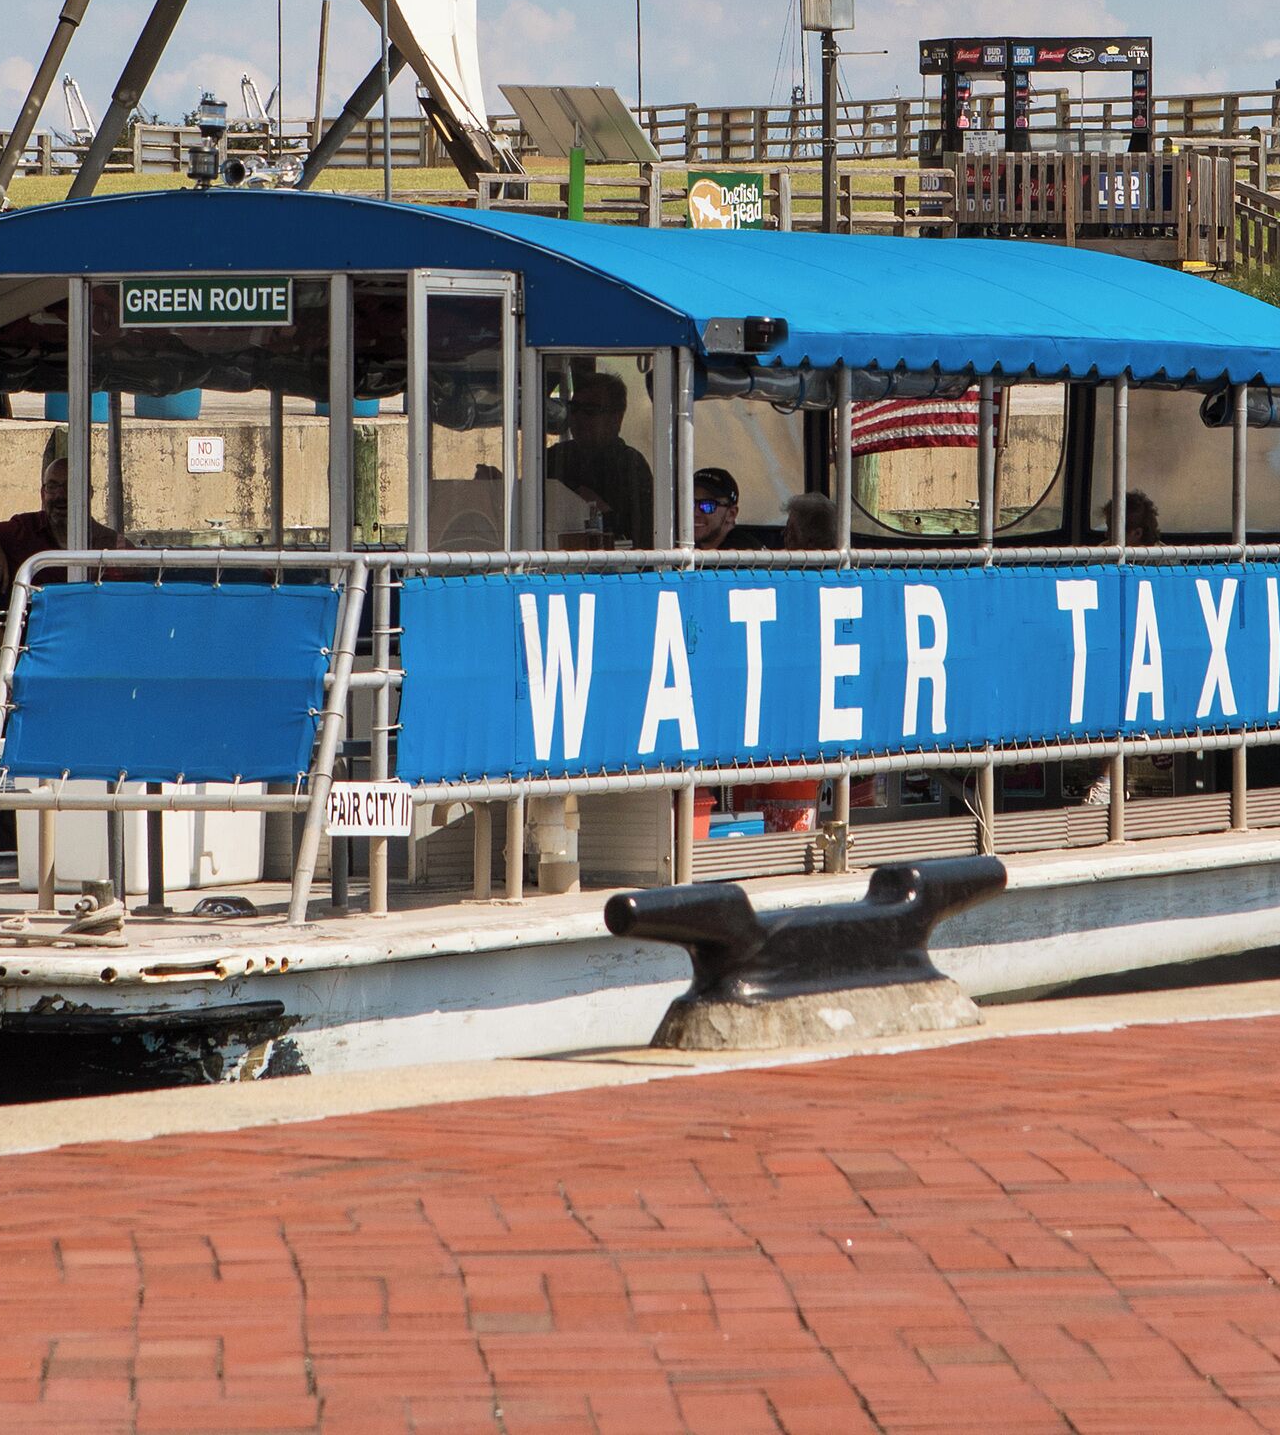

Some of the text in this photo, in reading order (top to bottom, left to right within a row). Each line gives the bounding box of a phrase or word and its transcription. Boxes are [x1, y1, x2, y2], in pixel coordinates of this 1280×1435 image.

[986, 47, 1001, 55] BUD
[1016, 48, 1031, 56] BUD
[1127, 50, 1149, 58] ULTRA
[984, 54, 1004, 63] LIGHT
[1013, 55, 1033, 63] LIGHT
[921, 176, 940, 191] BUD
[721, 183, 759, 206] Dogfish
[730, 198, 762, 229] Head
[126, 287, 287, 313] GREEN ROUTE
[197, 441, 213, 455] NO
[190, 457, 221, 467] DOCKING
[519, 584, 948, 761] WATER
[330, 791, 410, 827] FAIR CITY II
